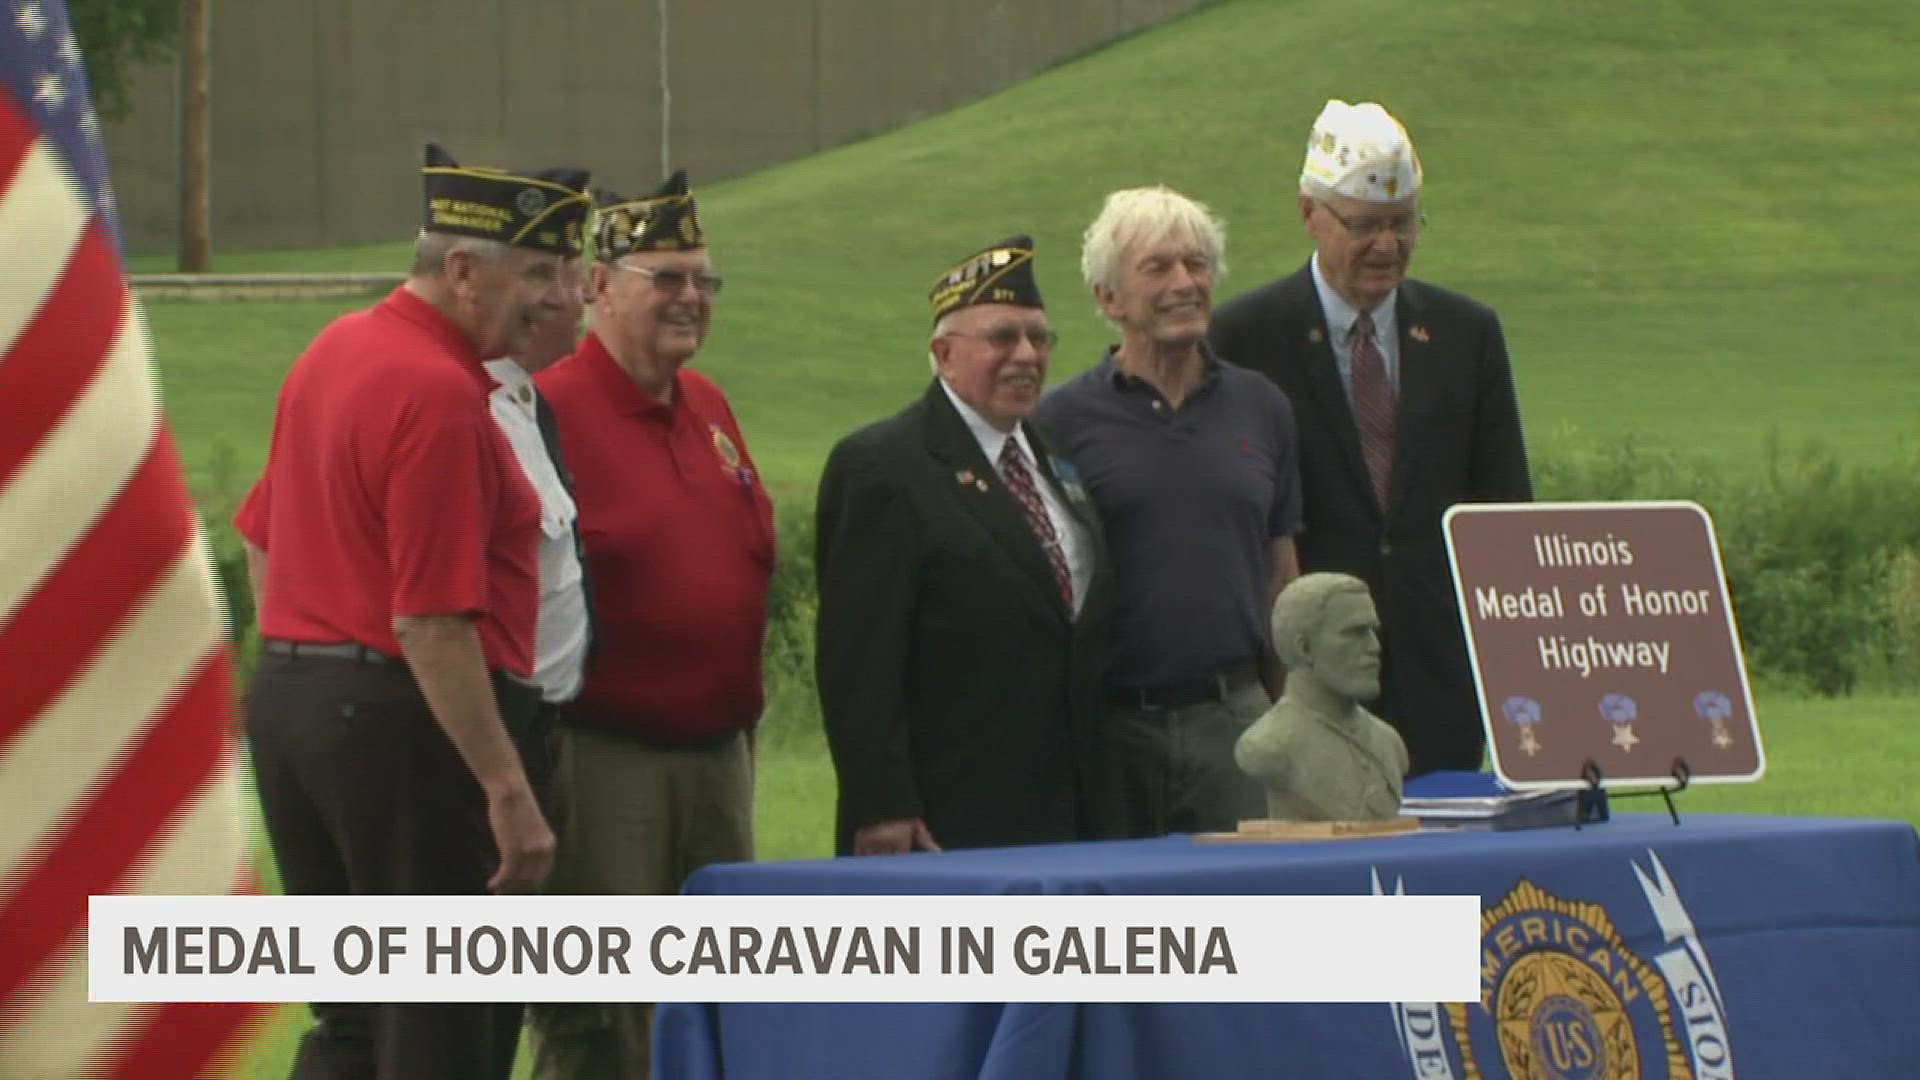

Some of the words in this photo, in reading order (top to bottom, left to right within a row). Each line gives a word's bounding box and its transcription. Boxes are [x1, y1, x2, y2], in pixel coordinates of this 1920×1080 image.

[1534, 534, 1634, 567] Illinois
[1475, 585, 1565, 620] Medal
[1579, 584, 1607, 617] of
[1622, 584, 1709, 616] Honor
[1538, 636, 1670, 678] Highway
[1405, 1008, 1447, 1077] DE
